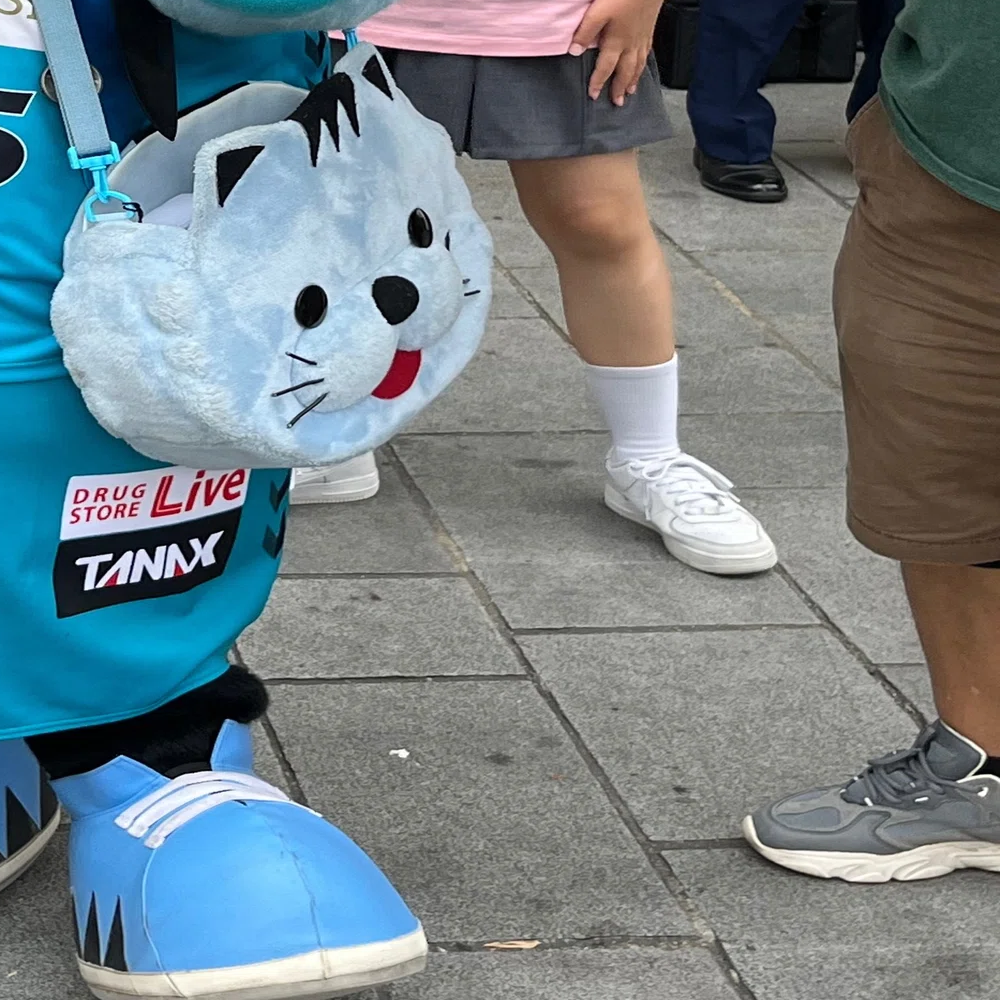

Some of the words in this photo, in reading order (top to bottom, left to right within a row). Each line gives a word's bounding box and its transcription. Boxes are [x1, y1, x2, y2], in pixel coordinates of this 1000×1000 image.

[73, 483, 147, 505] DRUG
[150, 469, 246, 518] Live
[69, 501, 141, 525] STORE
[75, 530, 225, 592] TANAX
